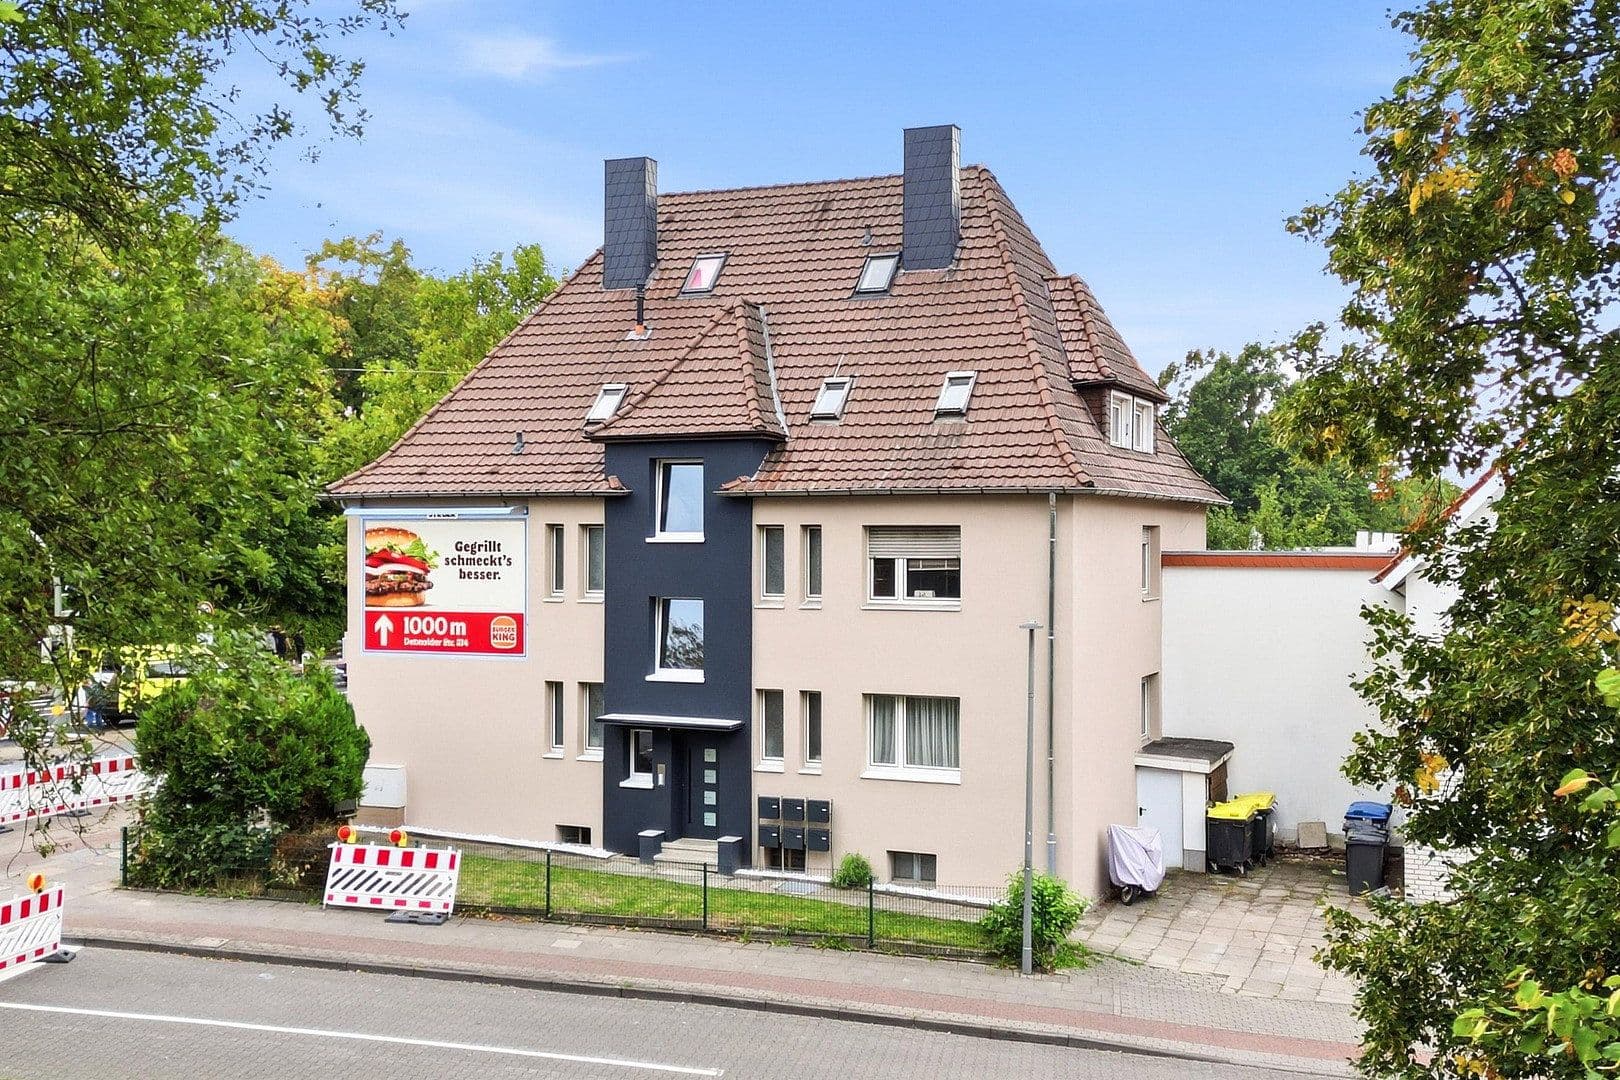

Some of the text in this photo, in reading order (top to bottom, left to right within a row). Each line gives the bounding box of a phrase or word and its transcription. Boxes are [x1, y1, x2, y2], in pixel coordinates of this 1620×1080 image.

[455, 540, 501, 555] Gegrillt
[444, 555, 512, 566] schmeckt's
[459, 568, 501, 580] besser.
[403, 616, 467, 636] 1000 m
[493, 633, 515, 641] KING
